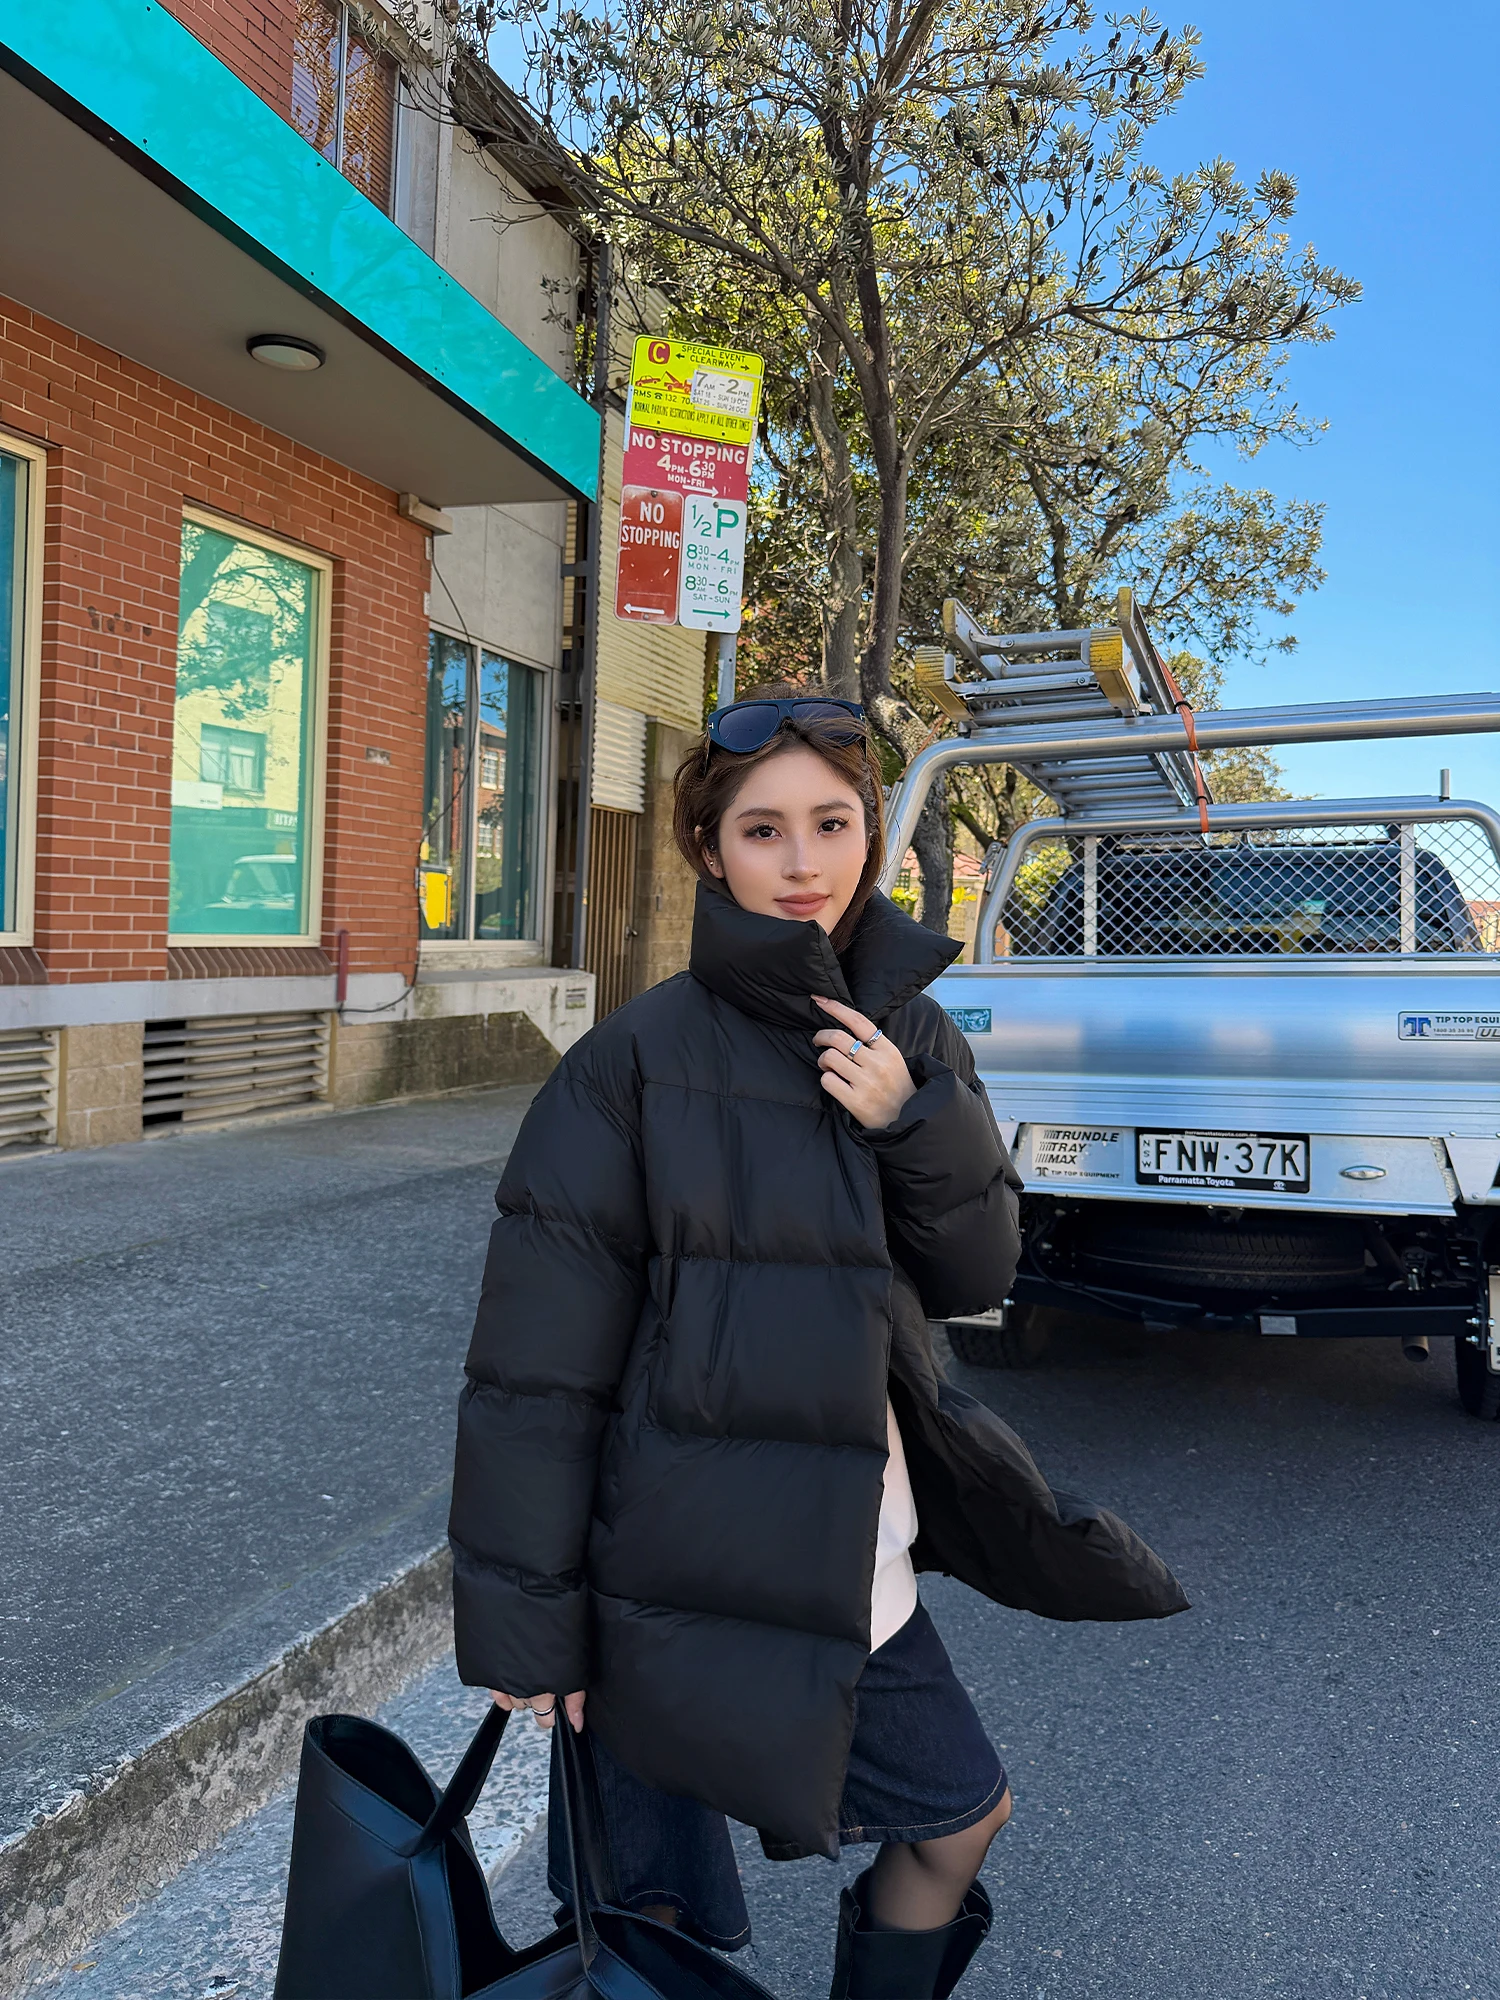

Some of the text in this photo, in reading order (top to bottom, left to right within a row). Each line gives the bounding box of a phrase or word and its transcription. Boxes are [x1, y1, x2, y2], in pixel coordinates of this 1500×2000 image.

[652, 343, 666, 363] C
[682, 345, 745, 363] SPECIAL EVENT
[690, 355, 735, 369] CLEARWAY
[634, 389, 652, 398] RMS
[665, 394, 677, 402] 132
[634, 402, 650, 414] NORMAL
[651, 404, 668, 417] PARKING
[669, 407, 695, 421] RESTRICTIONS
[696, 412, 709, 424] APPLY
[710, 415, 716, 425] AT
[725, 417, 737, 429] OTHER
[739, 420, 750, 431] TIMES
[632, 431, 745, 464] NO STOPPING
[640, 501, 665, 525] NO
[621, 525, 680, 549] STOPPING
[688, 561, 709, 571] MON
[720, 566, 737, 575] FRI
[1054, 1130, 1120, 1143] TRUNDLE
[1051, 1141, 1087, 1153] TRAY
[1048, 1154, 1078, 1165] MAX
[1080, 1171, 1120, 1179] EQUIPMENT
[1158, 1174, 1235, 1187] Parramatta Toyota
